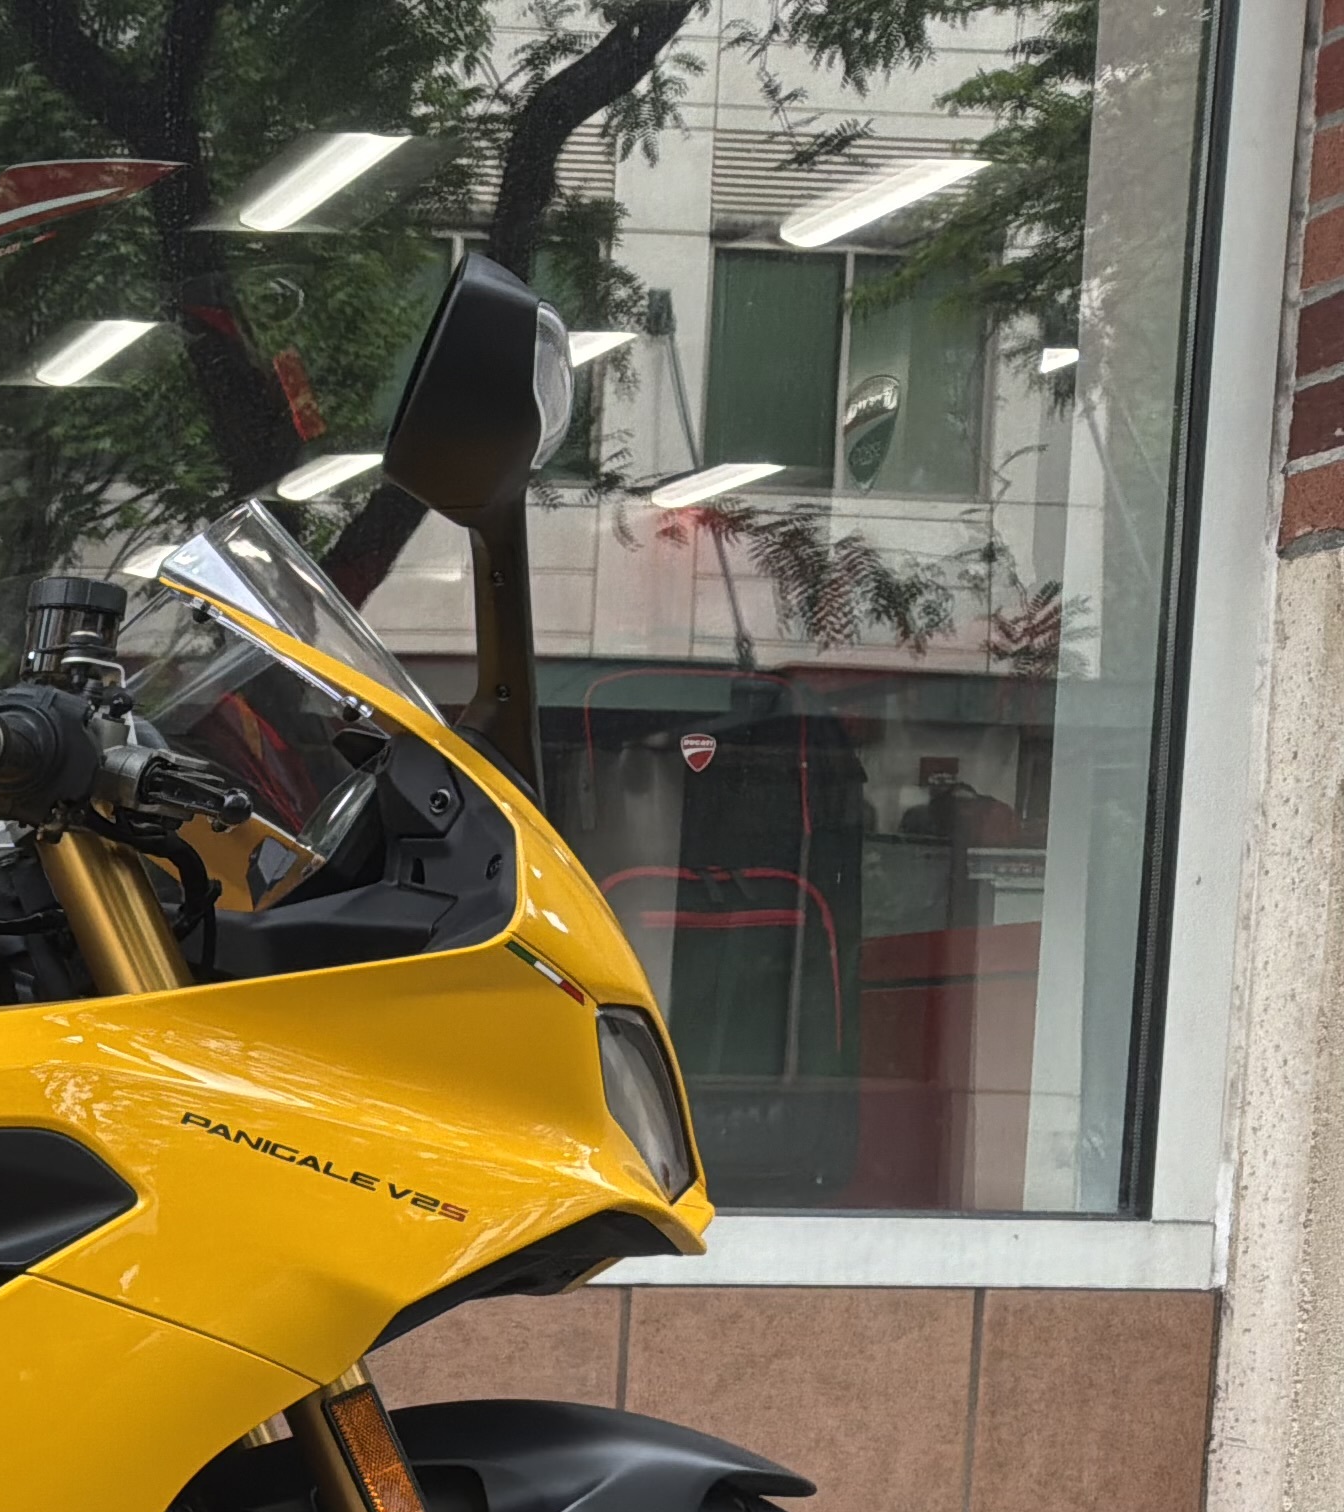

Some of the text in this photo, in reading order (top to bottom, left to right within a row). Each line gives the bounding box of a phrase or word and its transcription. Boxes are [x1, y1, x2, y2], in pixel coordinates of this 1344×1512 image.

[683, 739, 714, 747] DUCATI
[180, 1111, 470, 1223] PANIGALE V2S
